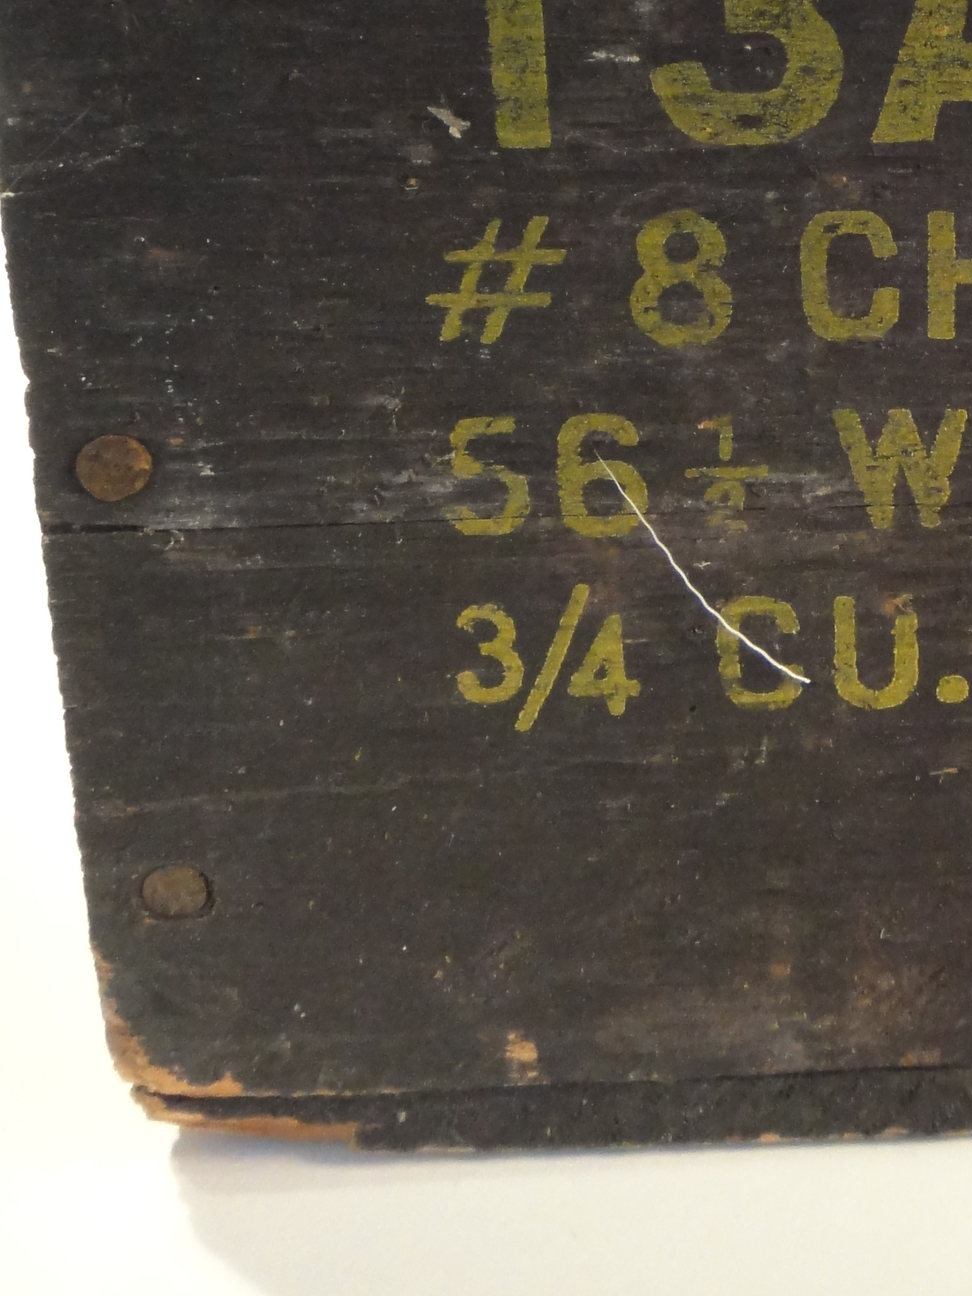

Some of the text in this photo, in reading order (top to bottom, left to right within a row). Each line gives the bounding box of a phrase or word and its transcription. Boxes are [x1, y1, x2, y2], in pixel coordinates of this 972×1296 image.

[629, 210, 732, 348] 8
[456, 583, 970, 732] 3/4 CU.
